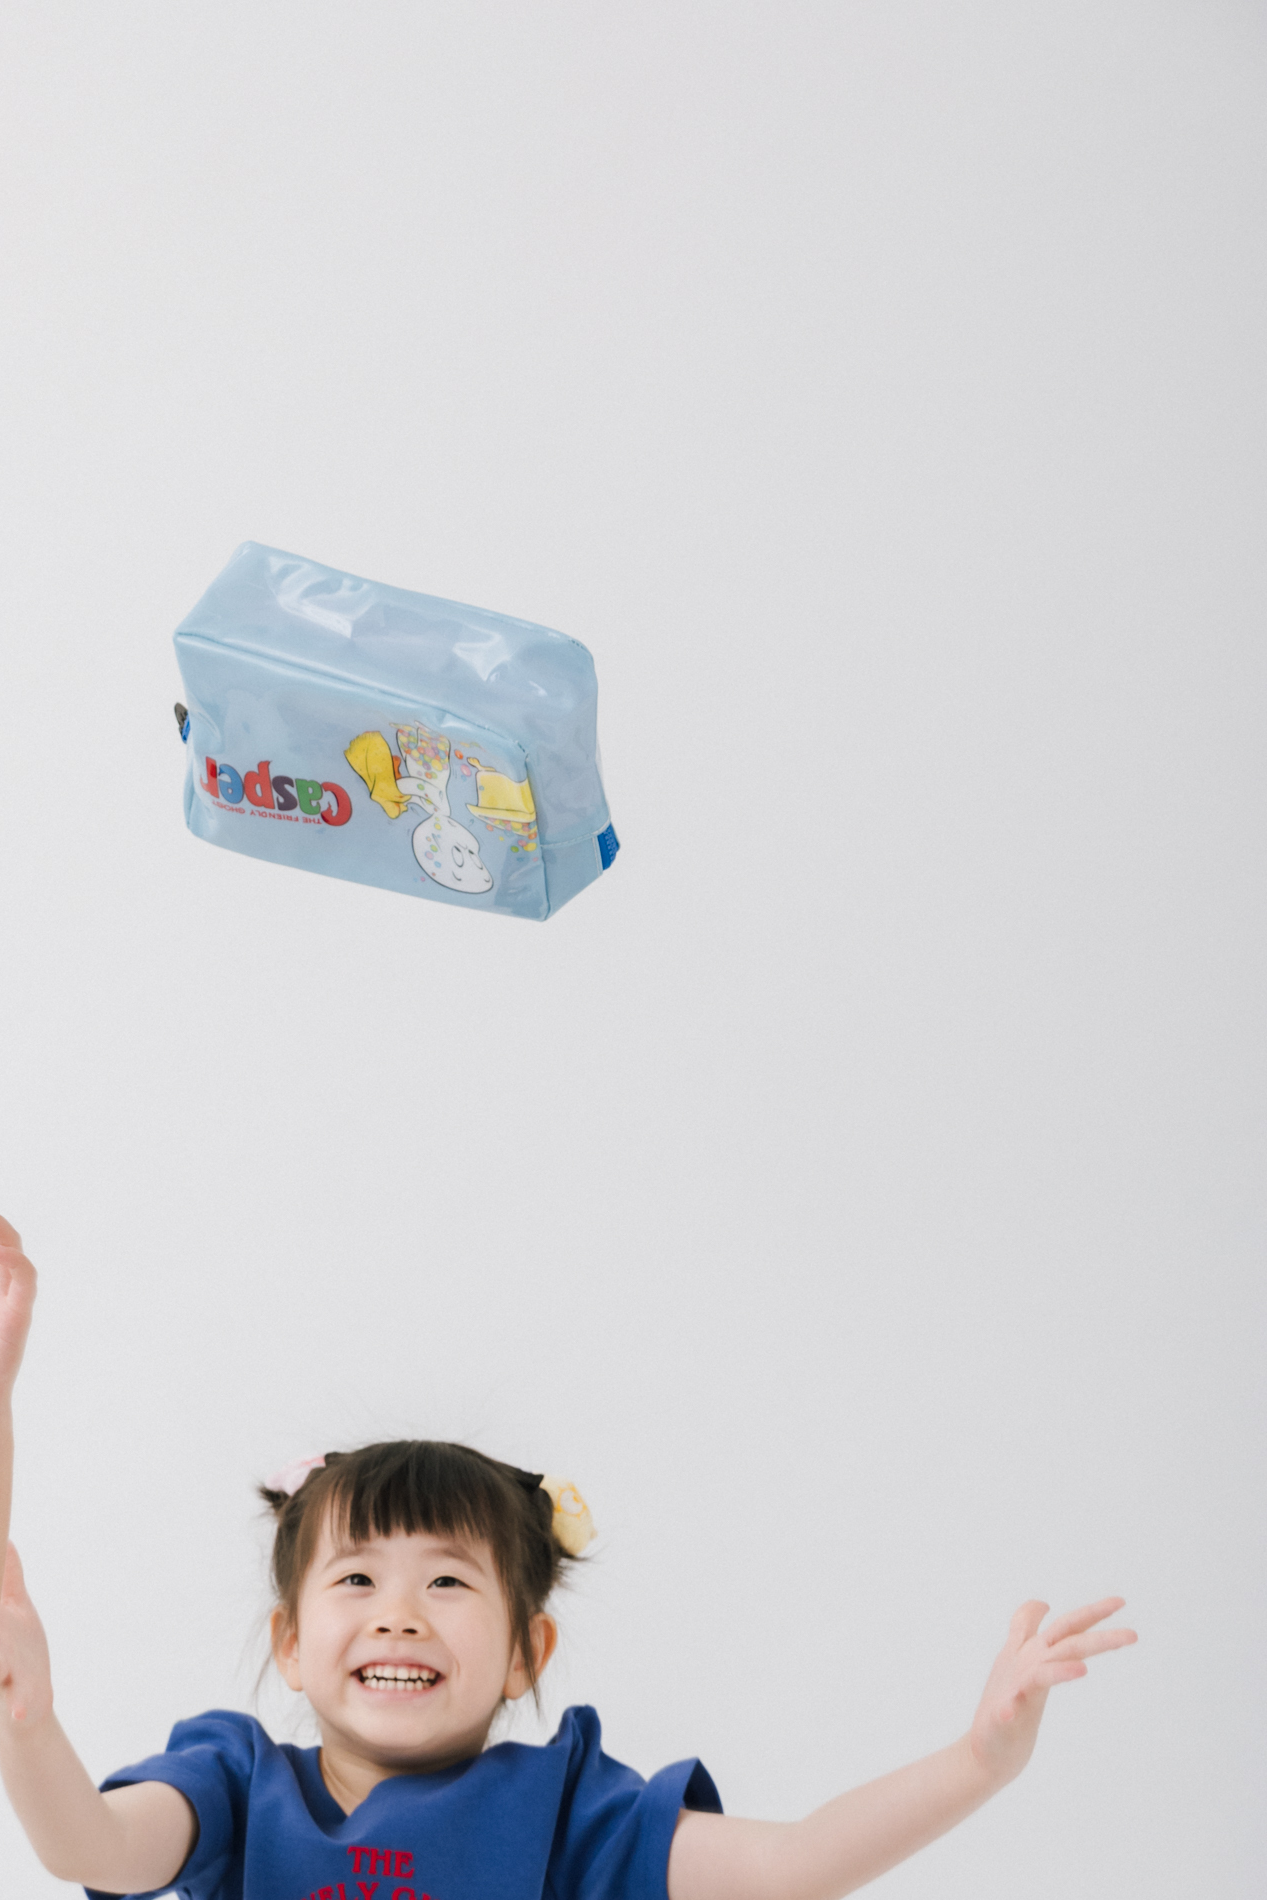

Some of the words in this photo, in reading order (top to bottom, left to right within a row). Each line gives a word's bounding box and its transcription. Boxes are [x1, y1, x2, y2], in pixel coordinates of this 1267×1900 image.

[200, 756, 353, 827] Casper
[250, 809, 300, 823] FRIENDLY
[302, 816, 322, 825] THE
[346, 1846, 415, 1879] THE
